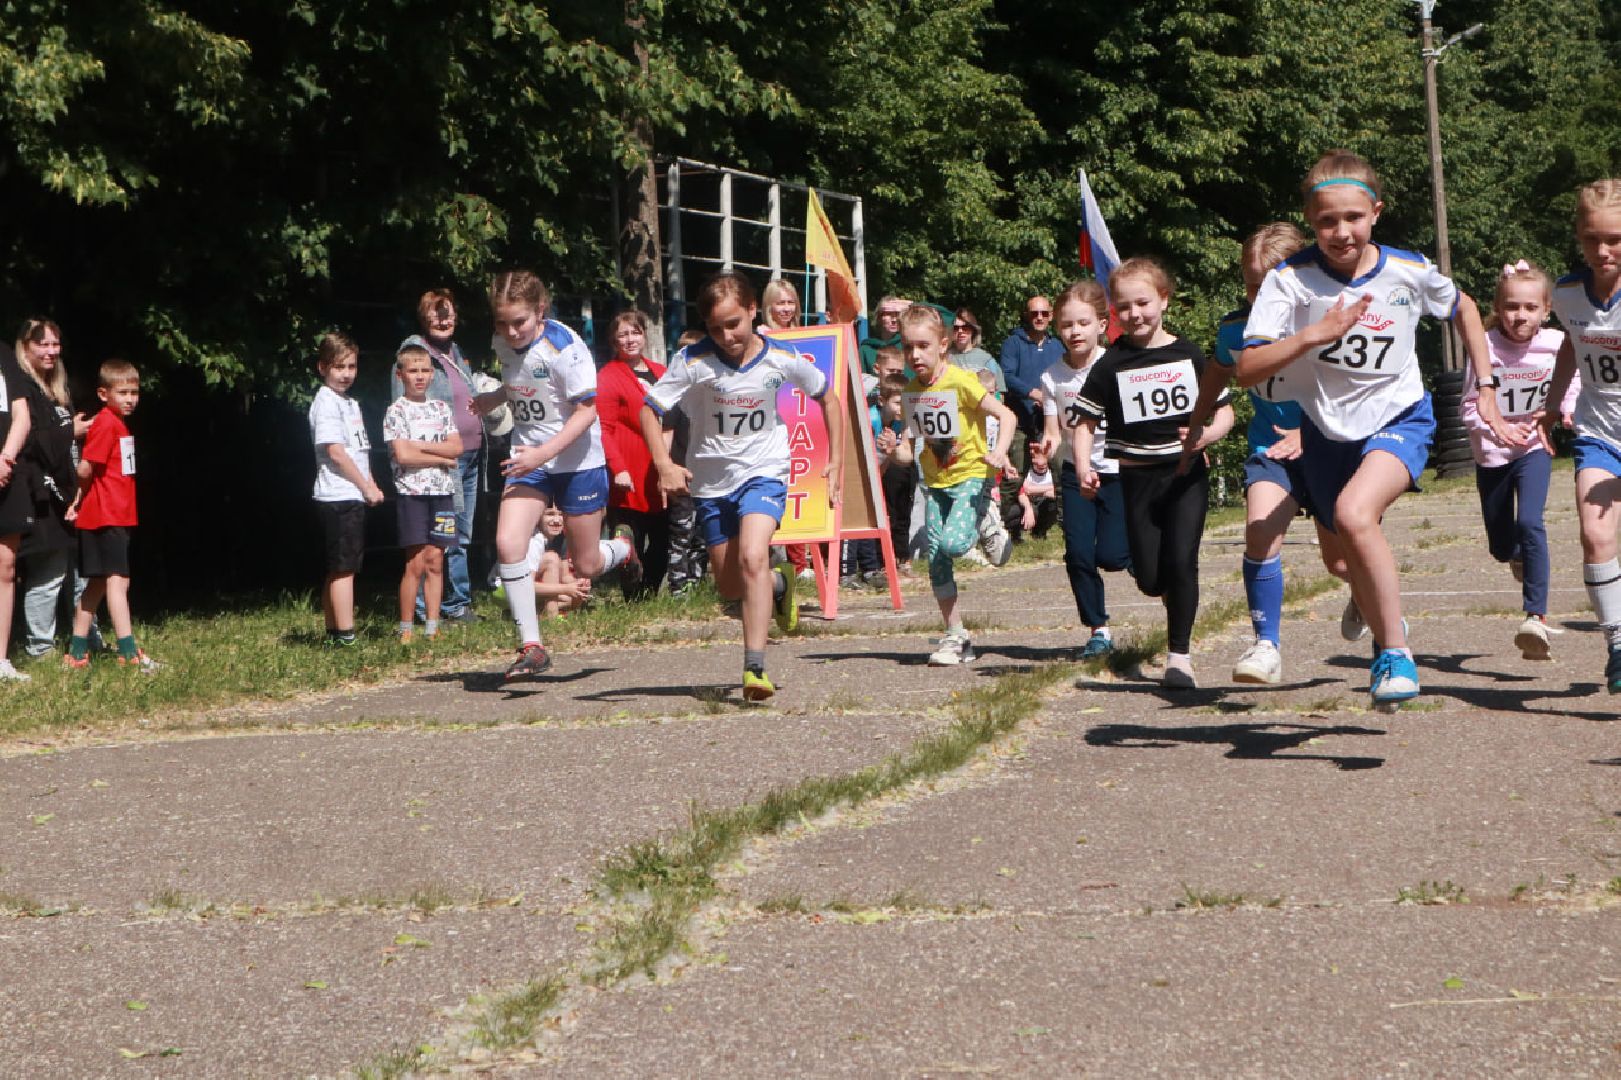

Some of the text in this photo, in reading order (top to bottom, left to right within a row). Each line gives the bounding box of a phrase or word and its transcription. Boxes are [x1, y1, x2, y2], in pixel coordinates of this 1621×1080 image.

[1318, 334, 1394, 370] 237
[1128, 369, 1172, 383] saucony
[1132, 384, 1189, 417] 196
[712, 410, 765, 436] 170
[912, 411, 952, 435] 150
